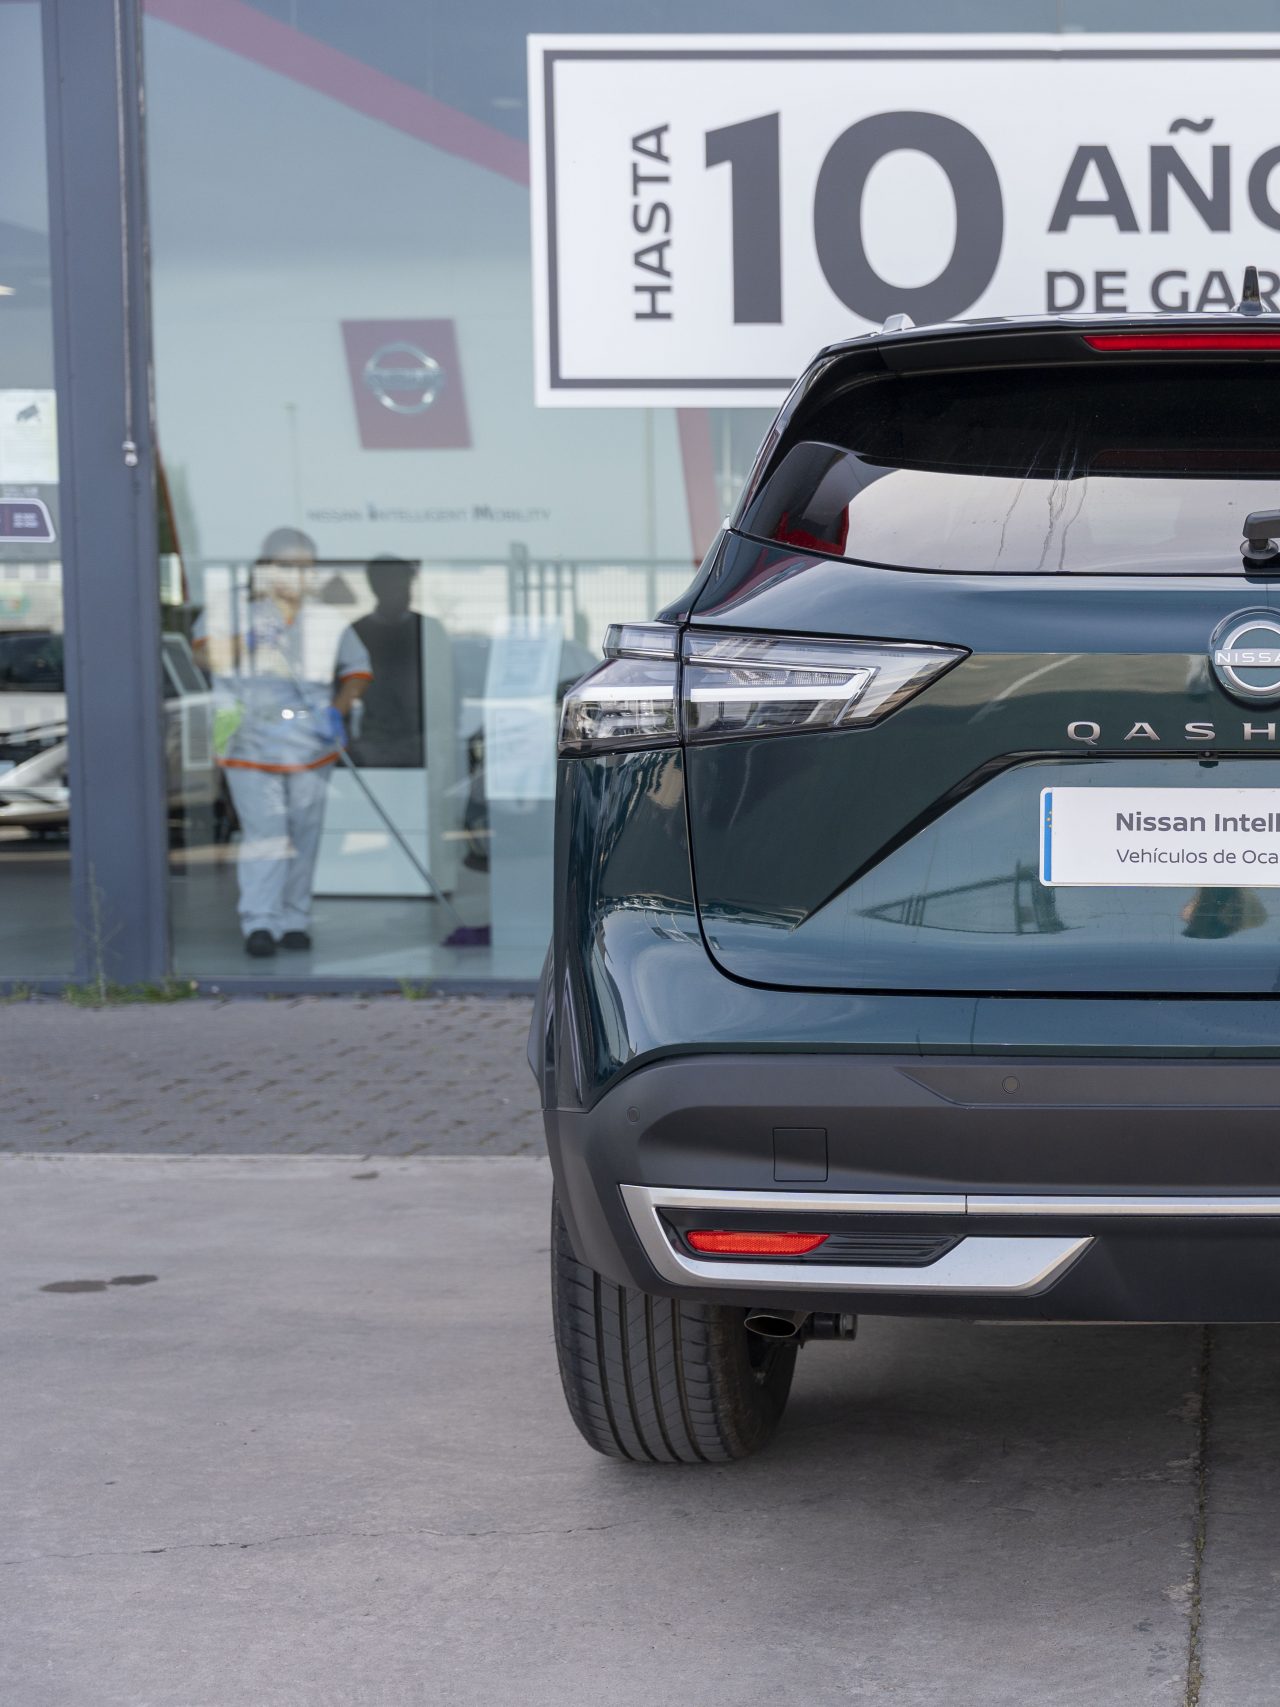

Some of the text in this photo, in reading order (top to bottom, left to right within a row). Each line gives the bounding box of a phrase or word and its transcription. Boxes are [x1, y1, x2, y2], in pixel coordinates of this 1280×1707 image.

[631, 123, 673, 320] HASTA
[705, 110, 1004, 328] 10
[1045, 270, 1127, 312] DE
[1116, 811, 1206, 833] Nissan
[1116, 847, 1208, 864] Vehículos
[1213, 848, 1237, 865] de
